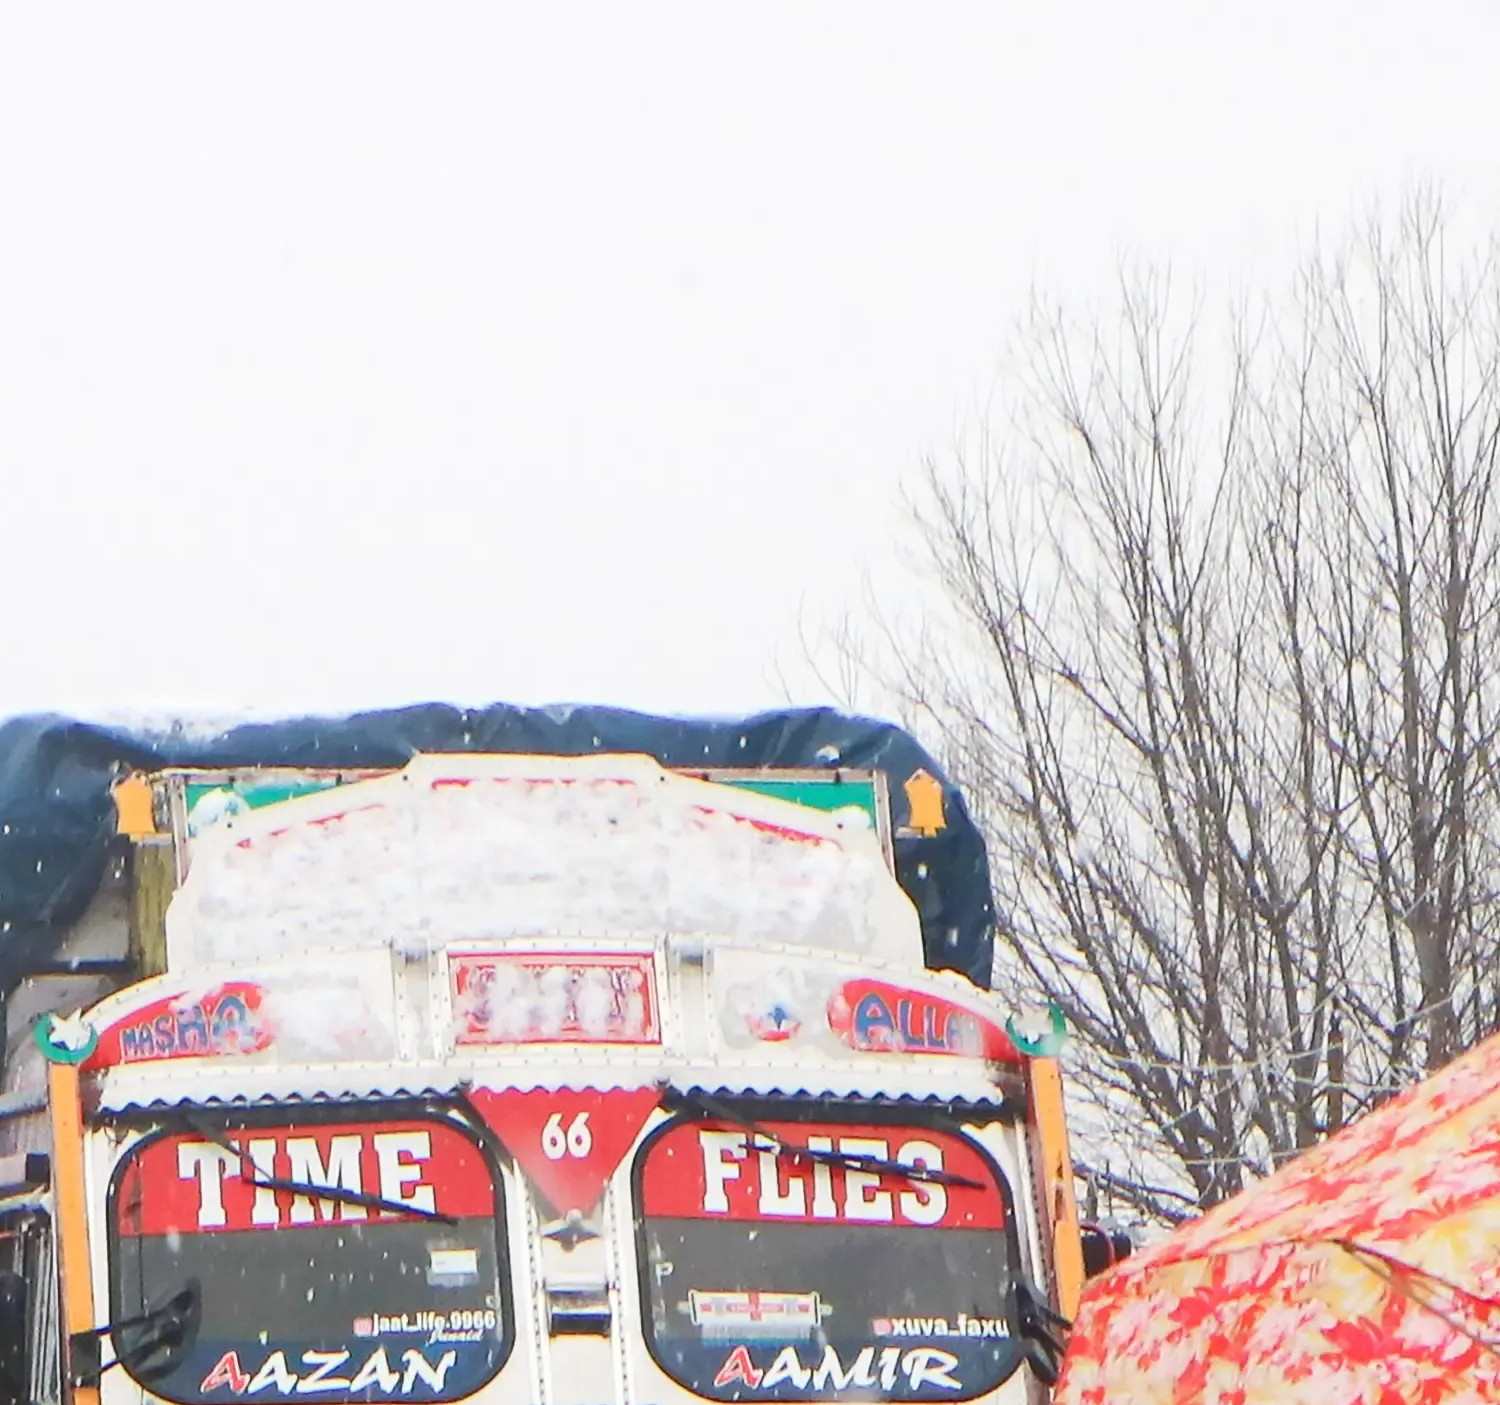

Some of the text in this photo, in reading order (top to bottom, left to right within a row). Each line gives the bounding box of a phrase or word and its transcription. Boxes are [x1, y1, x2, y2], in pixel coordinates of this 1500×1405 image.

[541, 1112, 592, 1160] 66
[177, 1131, 436, 1227] TIME
[698, 1129, 948, 1227] FLIES
[200, 1348, 456, 1396] AAZAN
[713, 1344, 963, 1392] AAMIR
